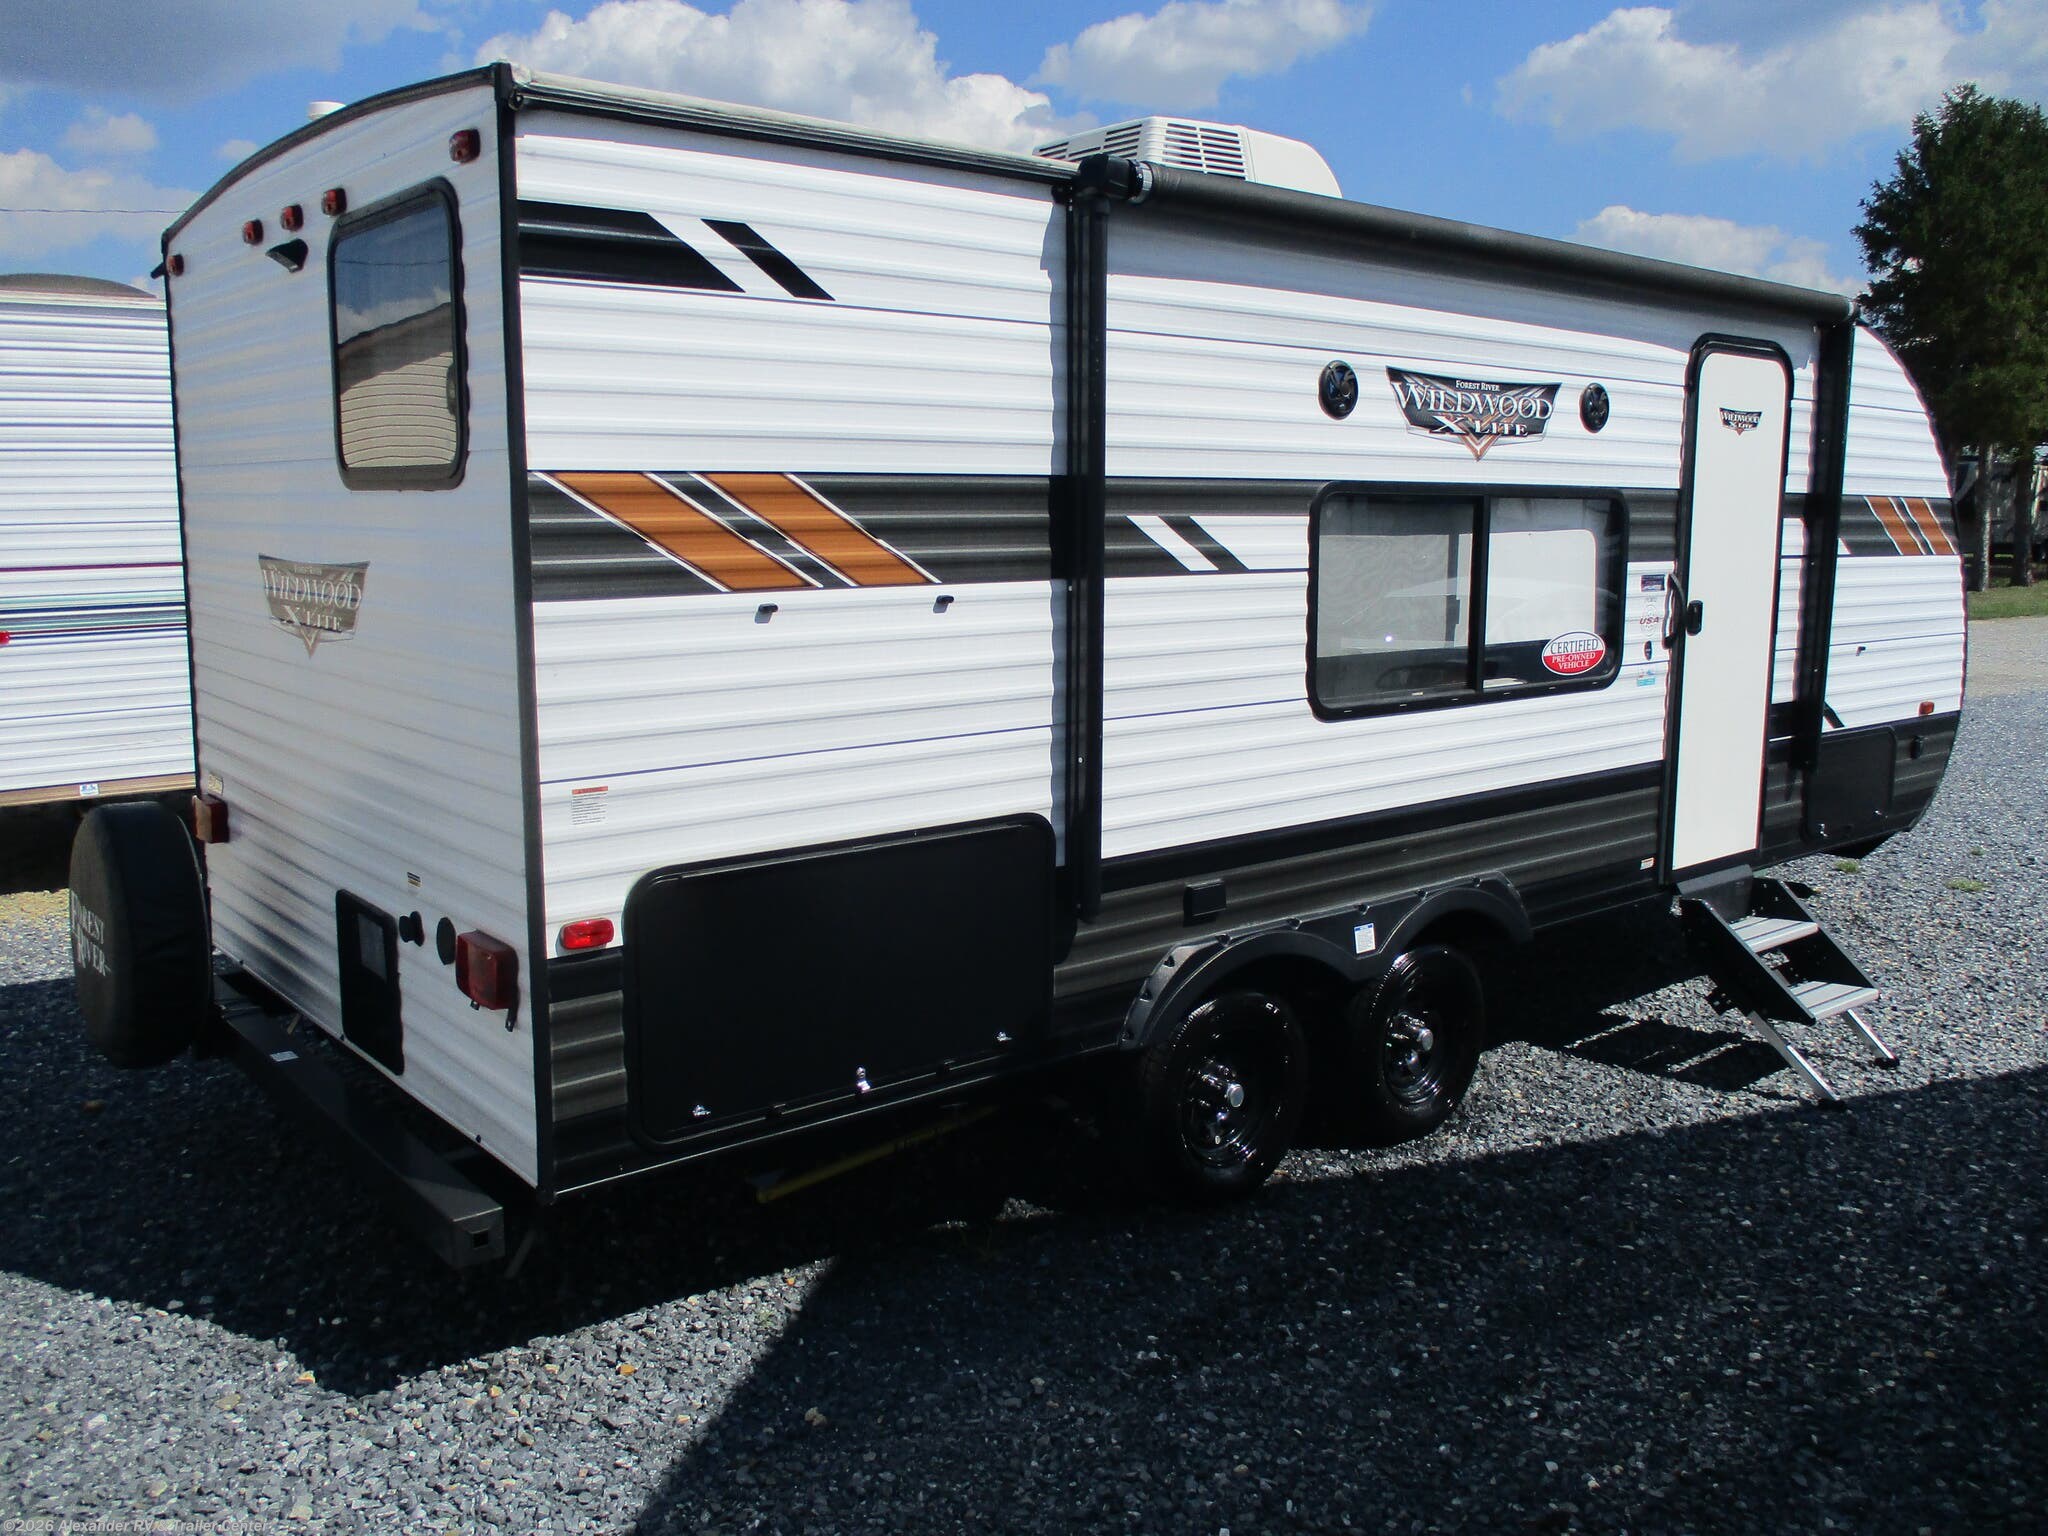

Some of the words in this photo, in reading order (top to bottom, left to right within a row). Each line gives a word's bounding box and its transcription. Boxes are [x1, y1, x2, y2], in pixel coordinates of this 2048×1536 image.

[1455, 380, 1480, 390] FOREST
[1481, 382, 1500, 391] RIVER
[1391, 381, 1553, 419] WILDWOOD
[1430, 415, 1467, 434] X
[1474, 420, 1529, 437] LITE
[261, 569, 362, 610] WILDWOOD
[306, 610, 343, 630] LITE
[1639, 616, 1660, 625] USA
[1551, 639, 1599, 654] CERTIFIED
[1552, 652, 1595, 663] PRE-OWNED
[1558, 660, 1589, 670] VEHICLE
[71, 889, 104, 944] FOREST
[75, 924, 109, 976] RIVER
